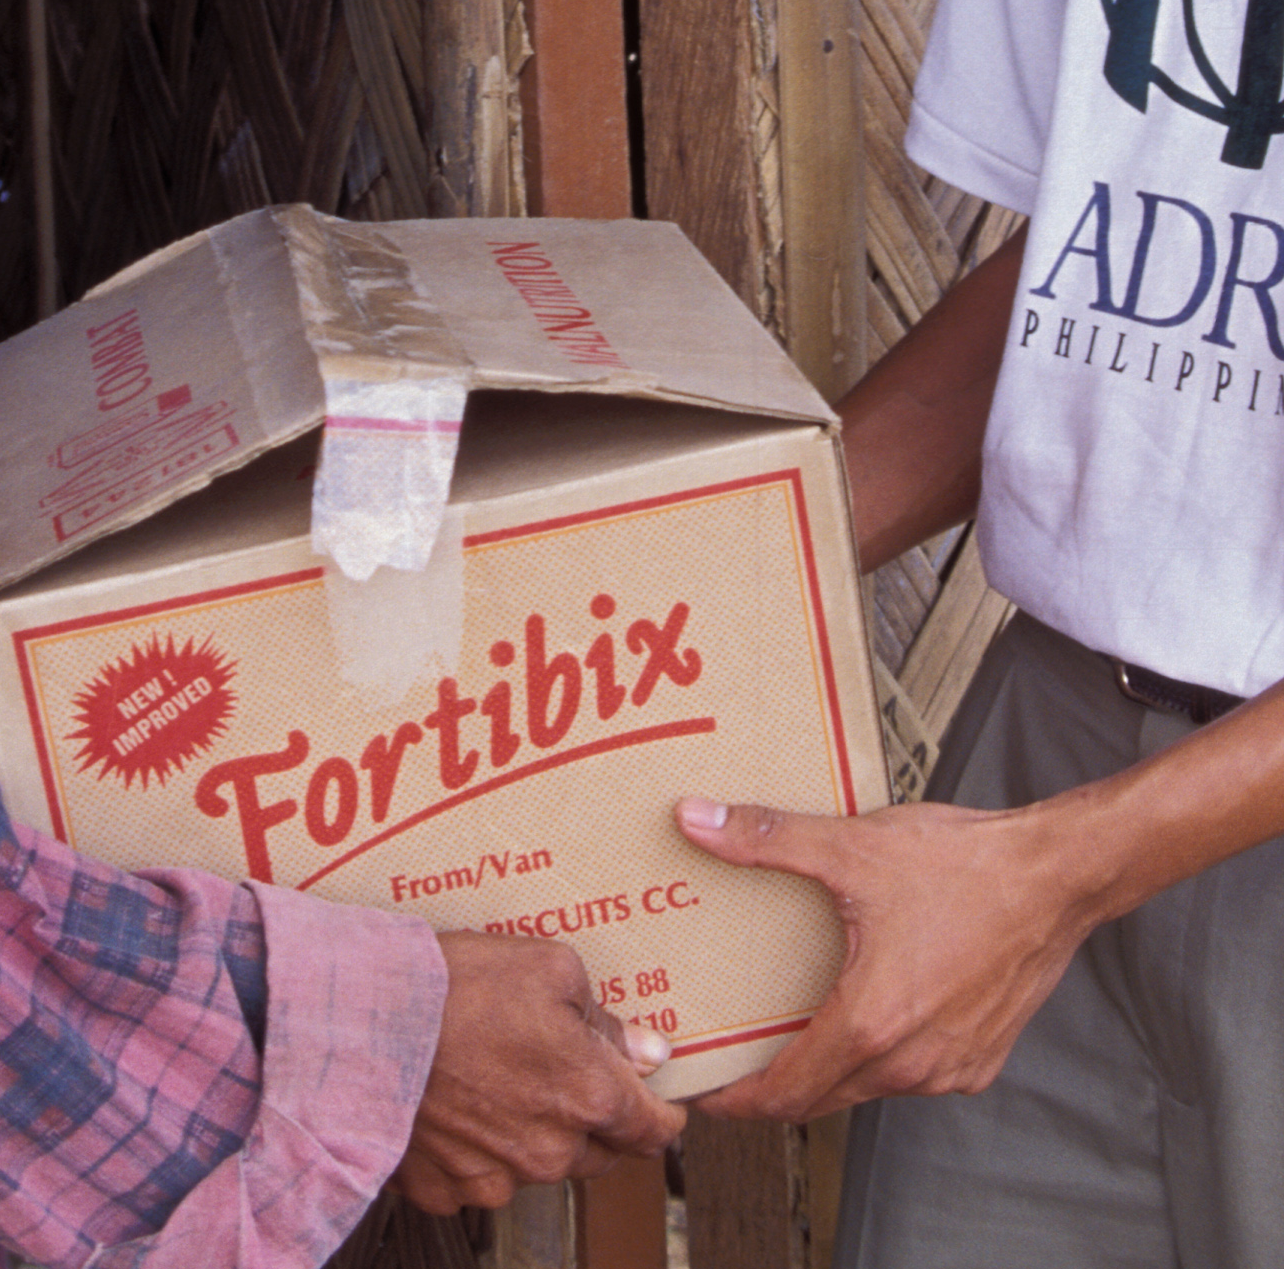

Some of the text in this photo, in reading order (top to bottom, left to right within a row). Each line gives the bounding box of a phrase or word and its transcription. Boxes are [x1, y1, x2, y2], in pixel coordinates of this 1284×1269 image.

[485, 241, 633, 369] MALNUTRITION
[86, 308, 153, 412] COMBAT
[112, 676, 212, 756] IMPROVED
[117, 677, 164, 719] NEW
[195, 593, 703, 885] Fortibix
[390, 849, 553, 903] From/Van
[641, 881, 700, 914] CC.
[635, 968, 670, 998] 88
